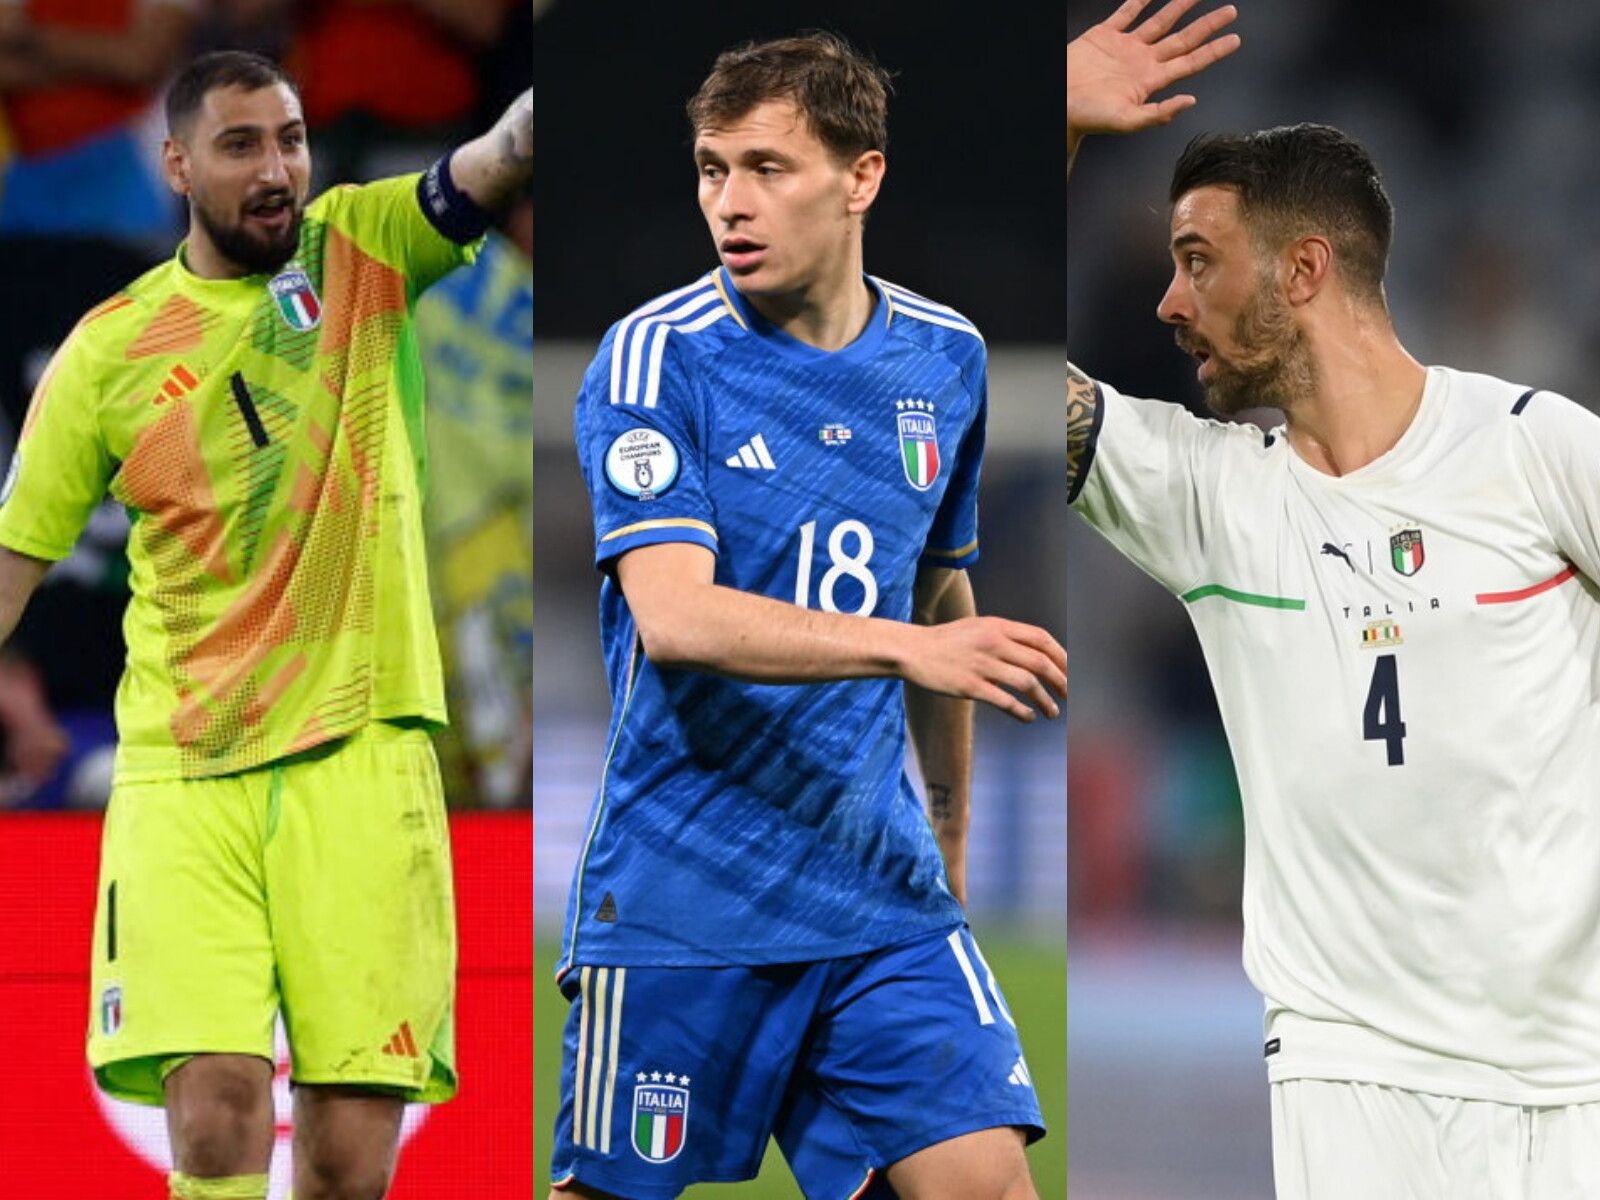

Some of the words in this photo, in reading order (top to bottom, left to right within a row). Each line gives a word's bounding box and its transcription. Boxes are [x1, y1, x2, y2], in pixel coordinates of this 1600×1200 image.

[231, 370, 270, 448] 1
[901, 418, 934, 434] ITALIA
[619, 442, 660, 453] EUROPEAN
[620, 450, 661, 460] CHAMPIONS
[795, 519, 878, 617] 18
[1342, 597, 1440, 619] TALIA
[1363, 654, 1406, 766] 4
[638, 1091, 683, 1108] ITALIA
